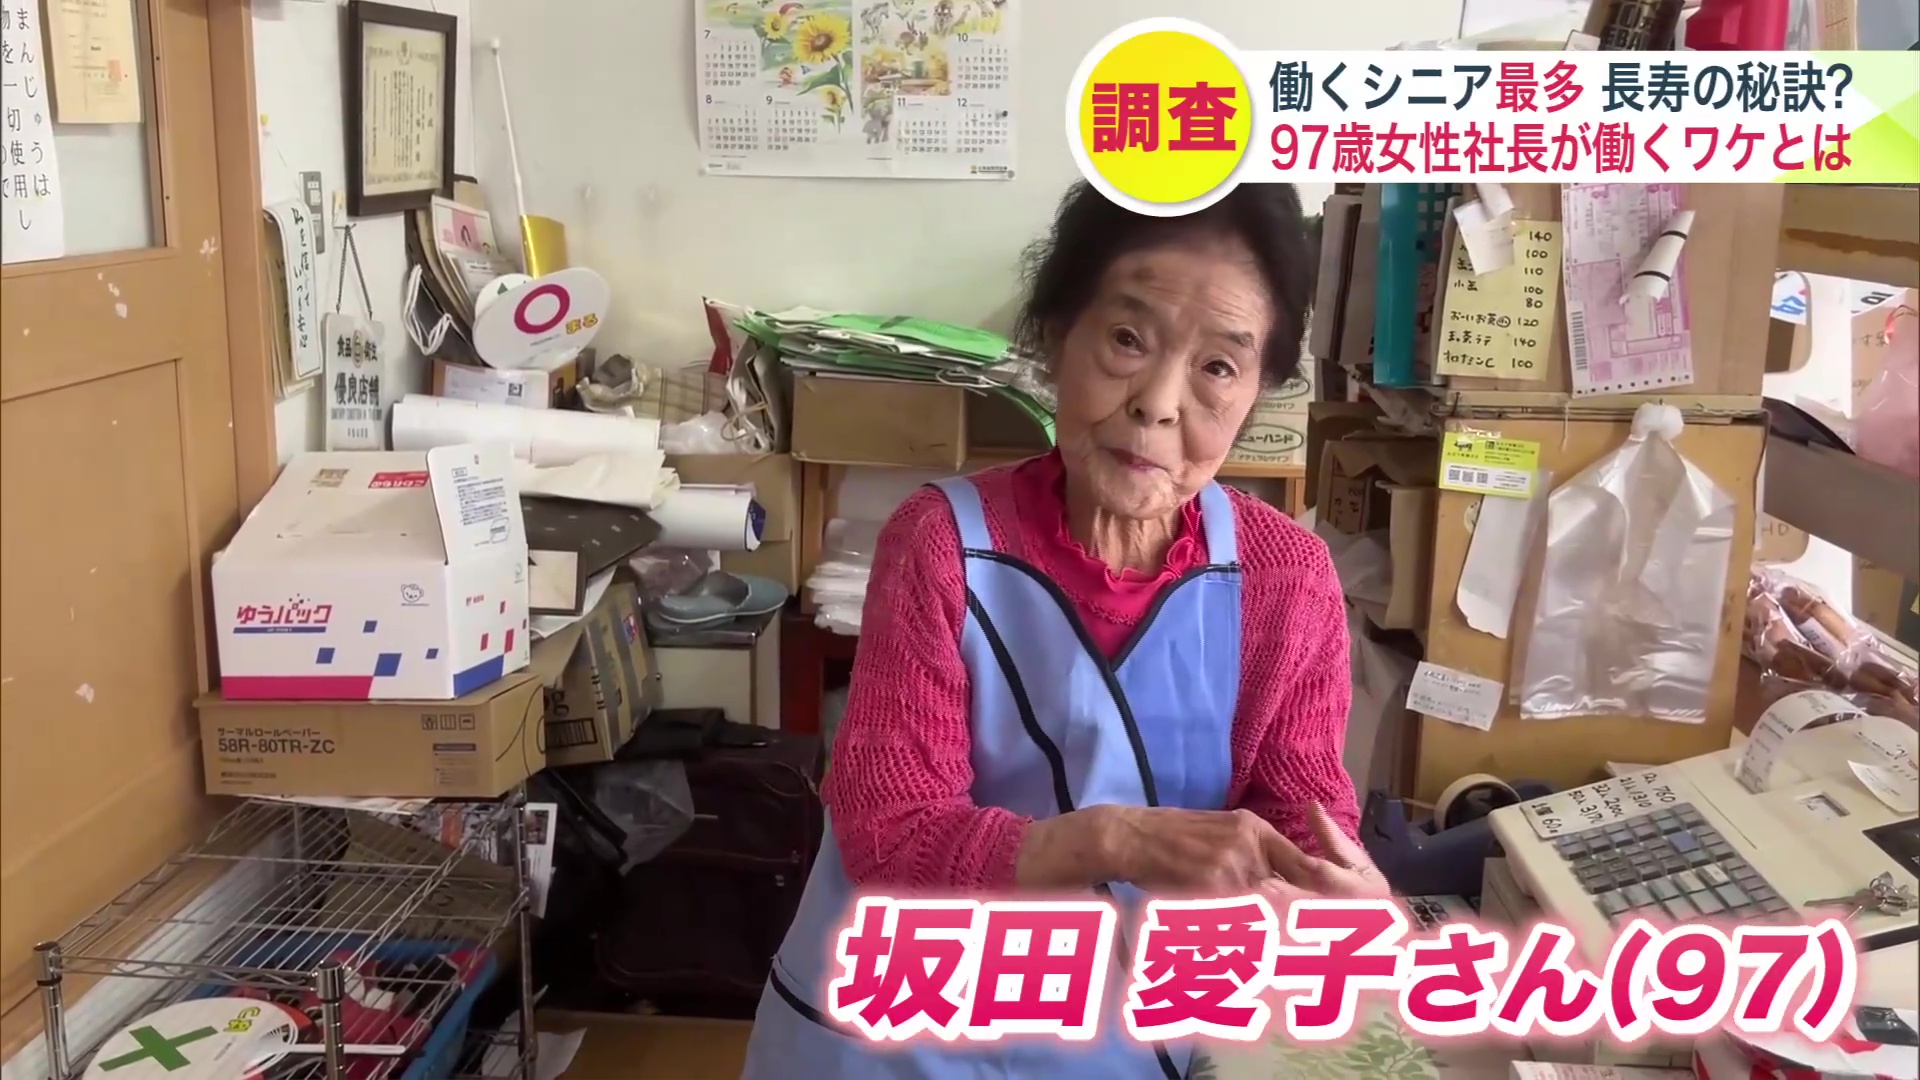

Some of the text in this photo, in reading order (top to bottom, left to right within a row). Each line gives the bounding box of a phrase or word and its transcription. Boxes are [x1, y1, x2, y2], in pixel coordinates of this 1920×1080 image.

[704, 30, 711, 39] 7
[958, 32, 969, 42] 10
[17, 8, 51, 196] まんじゅうは
[706, 94, 712, 104] 8
[766, 95, 773, 105] 9
[898, 98, 906, 107] 11
[958, 98, 967, 107] 12
[1530, 231, 1552, 241] 140
[1526, 249, 1548, 258] 100
[1524, 286, 1544, 295] 100
[1526, 298, 1543, 308] 80
[1518, 317, 1539, 327] 120
[1514, 338, 1536, 348] 140
[1512, 358, 1533, 368] 100
[236, 601, 332, 624] ゆうパック
[218, 728, 320, 738] サーマルロールペーパー
[218, 738, 336, 754] 58R-80TR-ZC
[1652, 786, 1676, 803] 760
